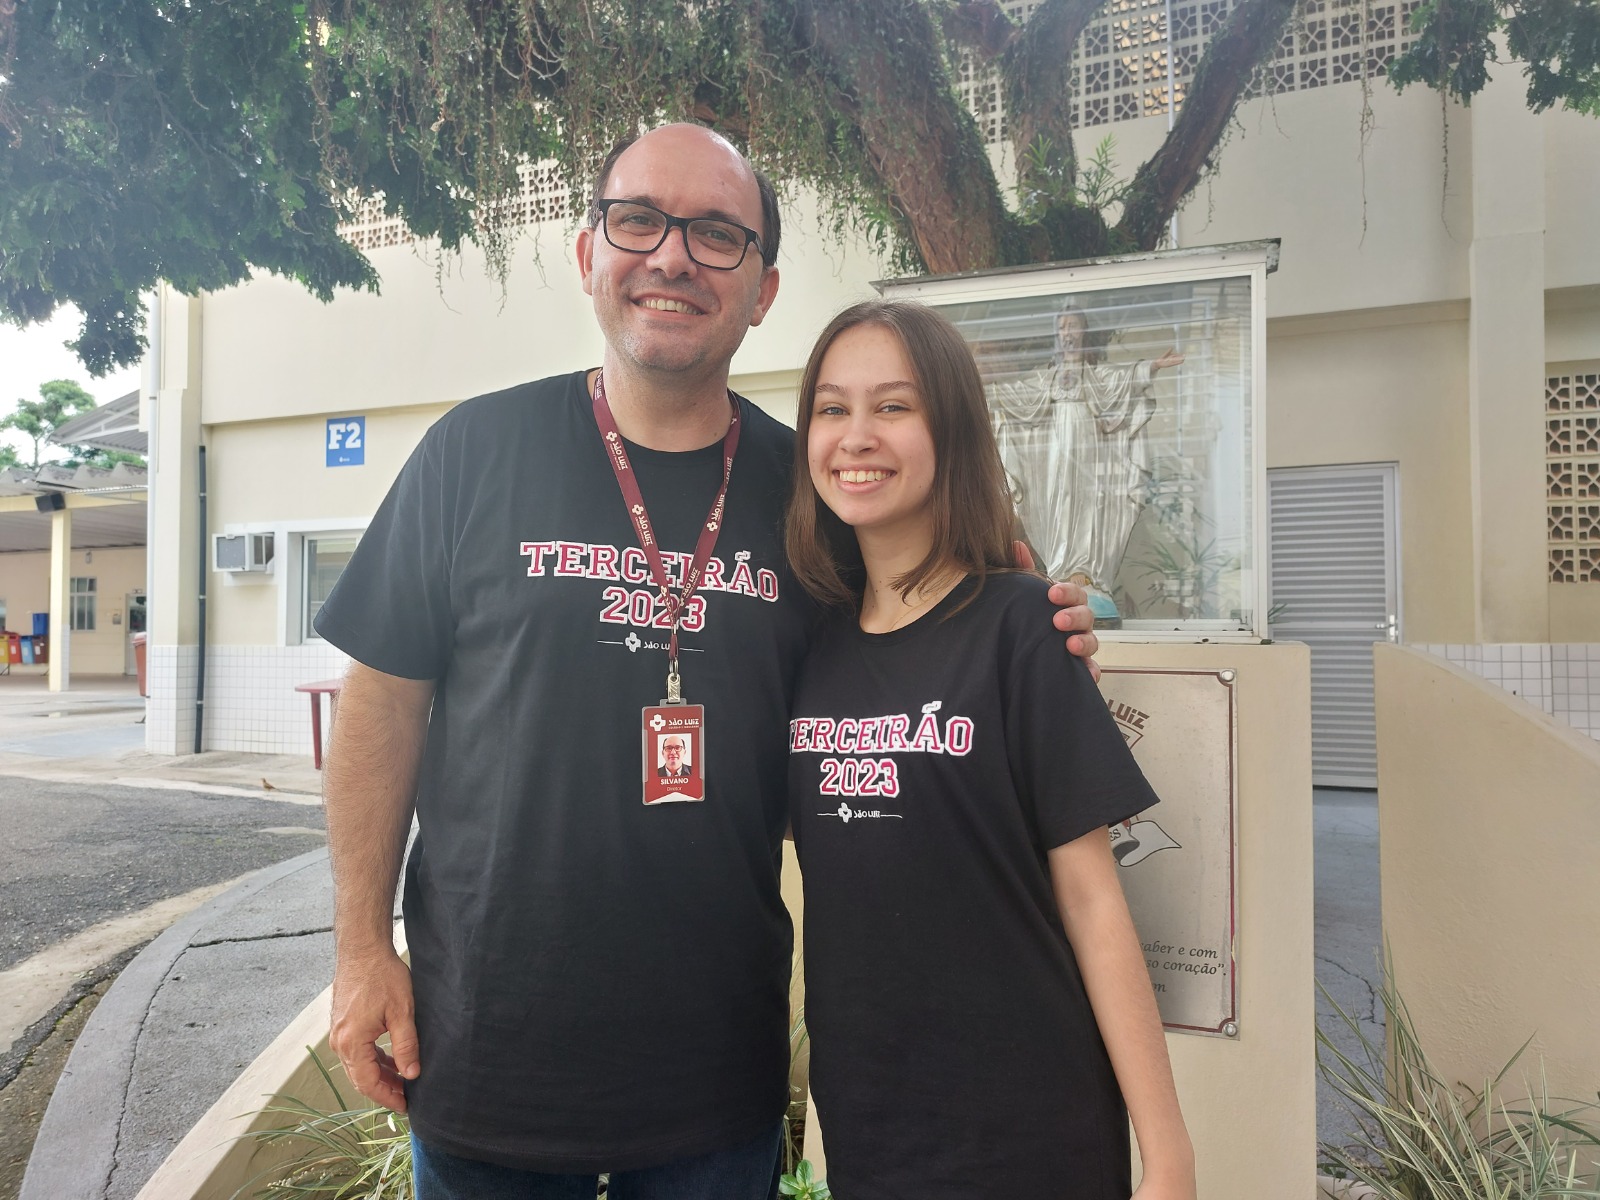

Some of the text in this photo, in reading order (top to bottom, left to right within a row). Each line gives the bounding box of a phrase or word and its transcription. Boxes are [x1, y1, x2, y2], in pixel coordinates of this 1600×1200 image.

[328, 422, 362, 450] F2
[520, 540, 779, 602] TERCEIRÃO
[600, 586, 707, 633] 2023
[643, 641, 660, 650] SÃO
[668, 717, 683, 726] SÃO
[660, 777, 689, 786] SILVANO
[819, 758, 900, 798] 2023
[853, 809, 868, 819] SÃO
[1178, 946, 1185, 955] e
[1189, 947, 1218, 959] com
